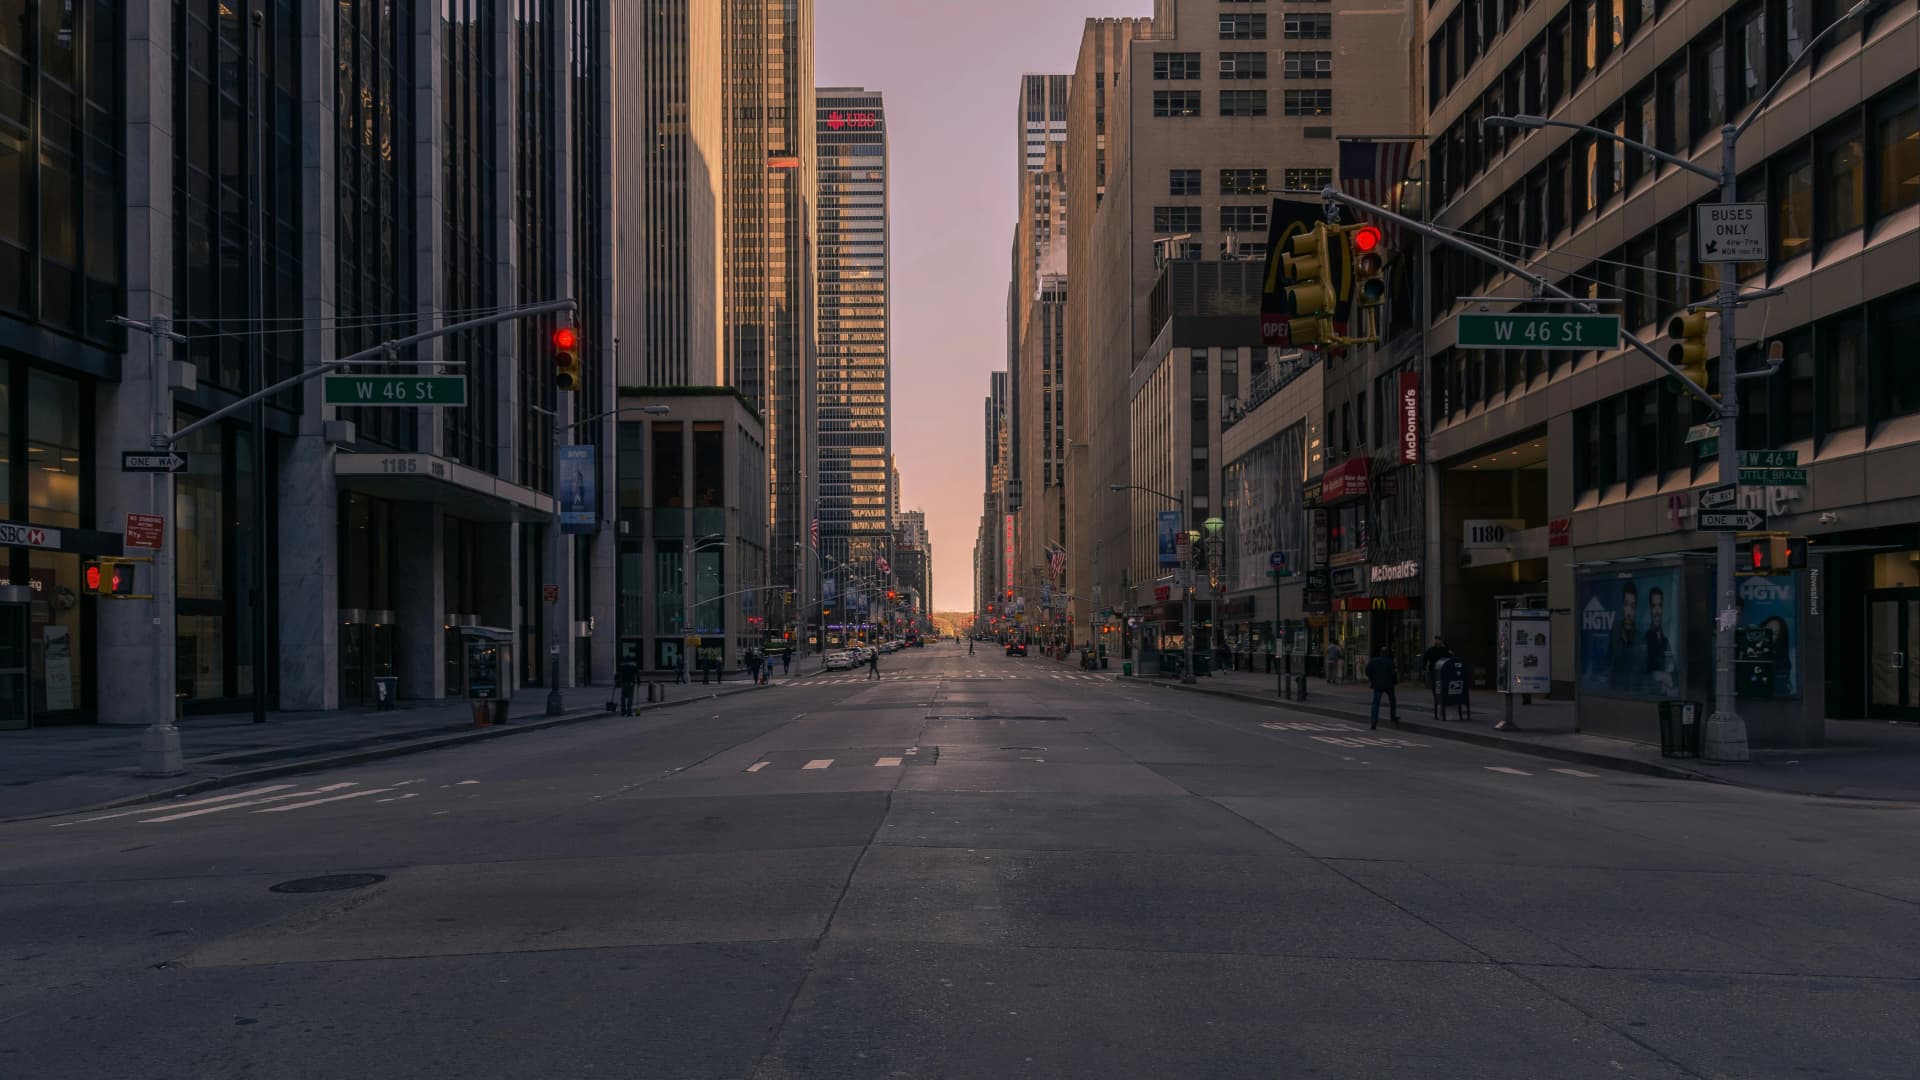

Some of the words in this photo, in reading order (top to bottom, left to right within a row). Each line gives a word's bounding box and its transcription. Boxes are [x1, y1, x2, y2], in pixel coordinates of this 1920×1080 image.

[1711, 209, 1753, 221] BUSES
[1716, 224, 1749, 235] ONLY
[1264, 322, 1288, 337] OPE
[1494, 320, 1514, 341] W
[1524, 320, 1551, 341] 46
[1562, 320, 1583, 342] St
[355, 381, 373, 399] W
[383, 381, 406, 399] 46
[416, 381, 434, 399] St
[1405, 388, 1417, 460] McDonald's
[131, 458, 150, 466] ONE
[159, 458, 177, 466] WAY
[381, 458, 417, 473] 1185
[1749, 453, 1760, 466] W
[1765, 453, 1783, 466] 46
[1738, 470, 1769, 480] LITTLE
[1772, 470, 1805, 480] BRAZIL
[1707, 516, 1726, 524] ONE
[1736, 515, 1756, 525] WAY
[1472, 526, 1504, 542] 1180
[1371, 560, 1418, 583] McDonald's
[1740, 581, 1791, 600] HGTV
[1583, 609, 1616, 630] HGTV
